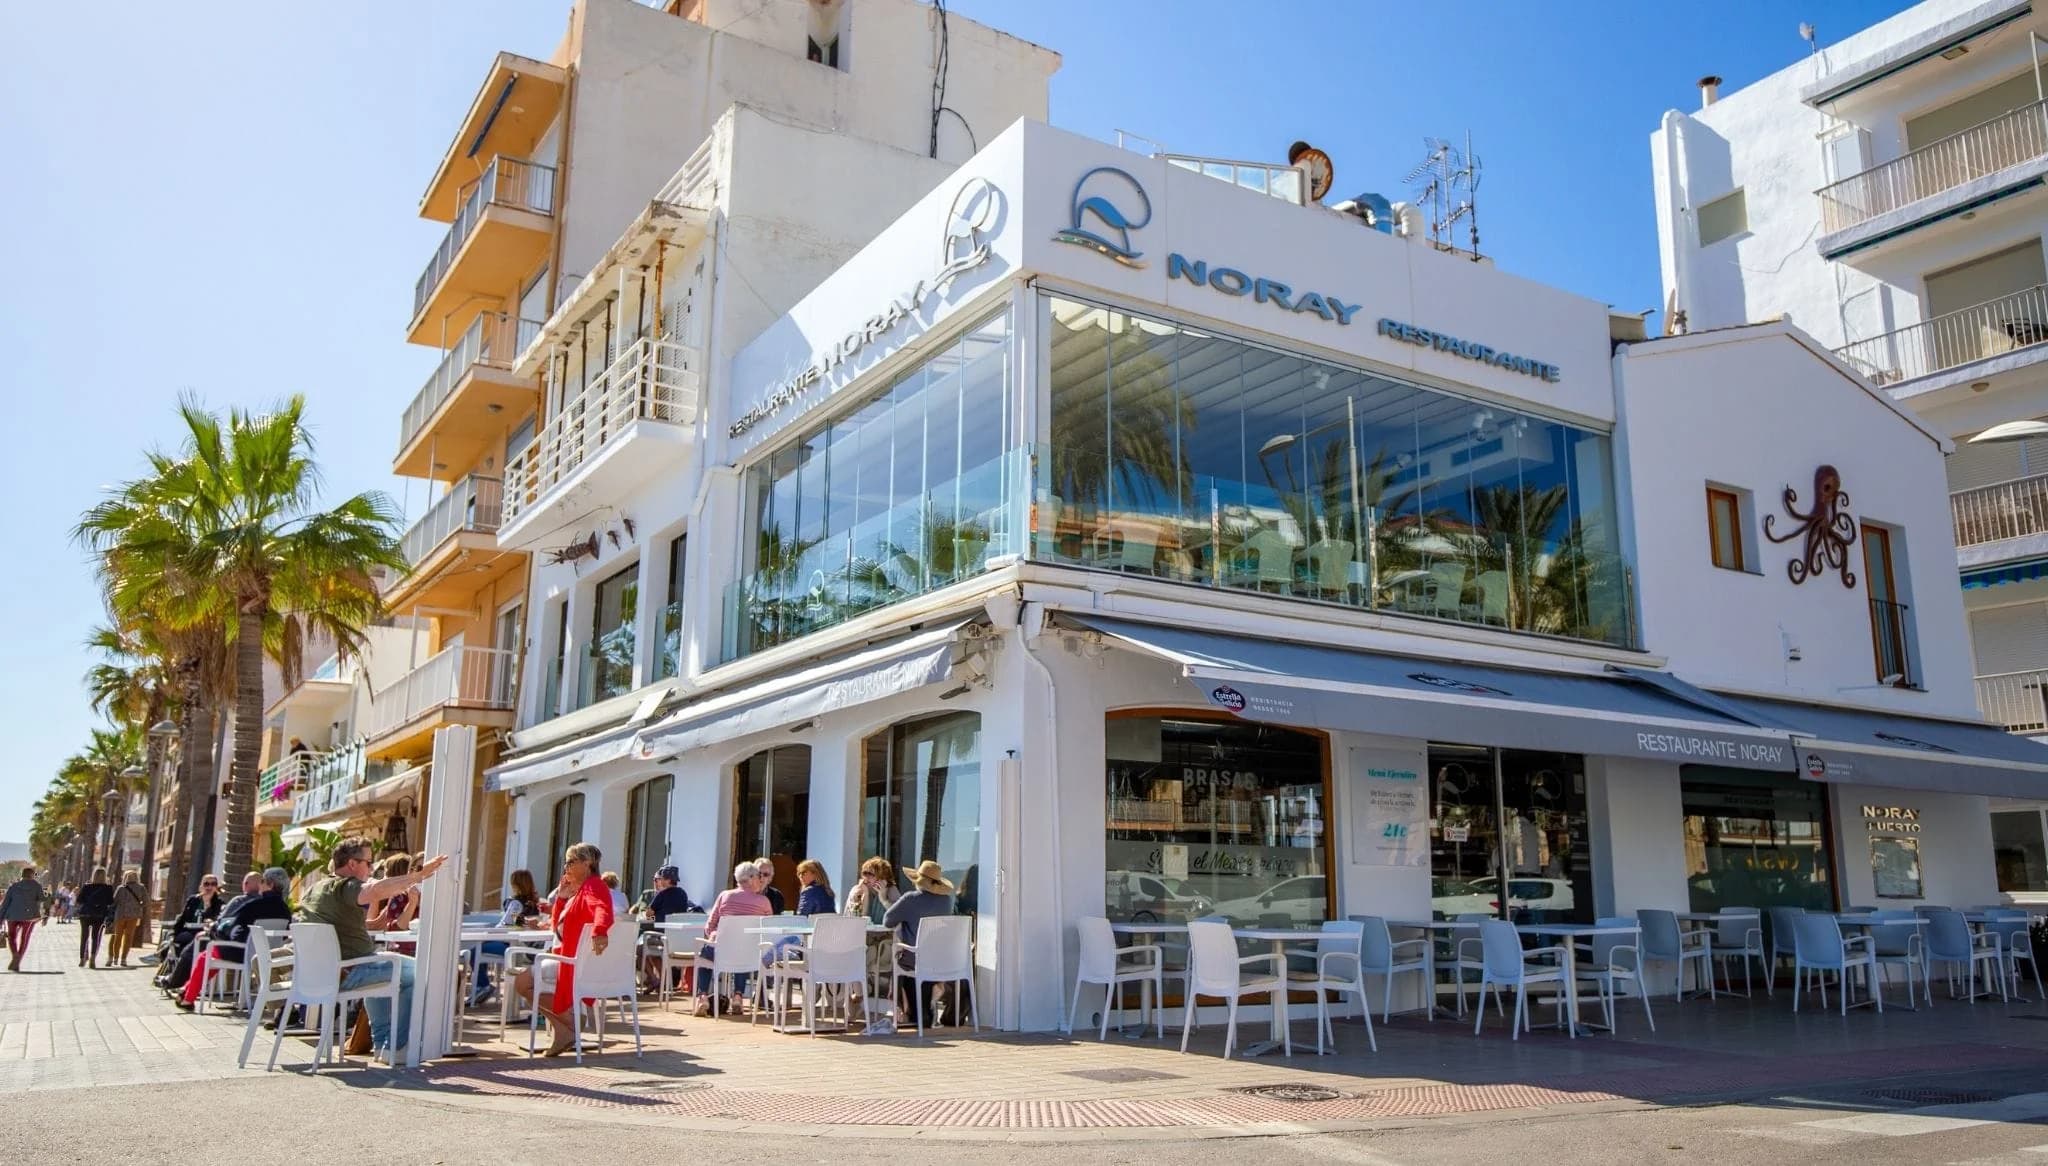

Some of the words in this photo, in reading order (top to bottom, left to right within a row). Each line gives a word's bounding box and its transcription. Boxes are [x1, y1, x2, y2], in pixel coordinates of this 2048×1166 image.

[1168, 252, 1363, 325] NORAY
[1378, 317, 1560, 383] RESTAURANTE
[728, 365, 820, 439] RESTAURANTE
[819, 280, 925, 374] NORAY
[1637, 733, 1737, 759] RESTAURANTE
[1741, 744, 1783, 763] NORAY
[1183, 768, 1259, 791] BRASAS
[1862, 805, 1920, 820] NORAY
